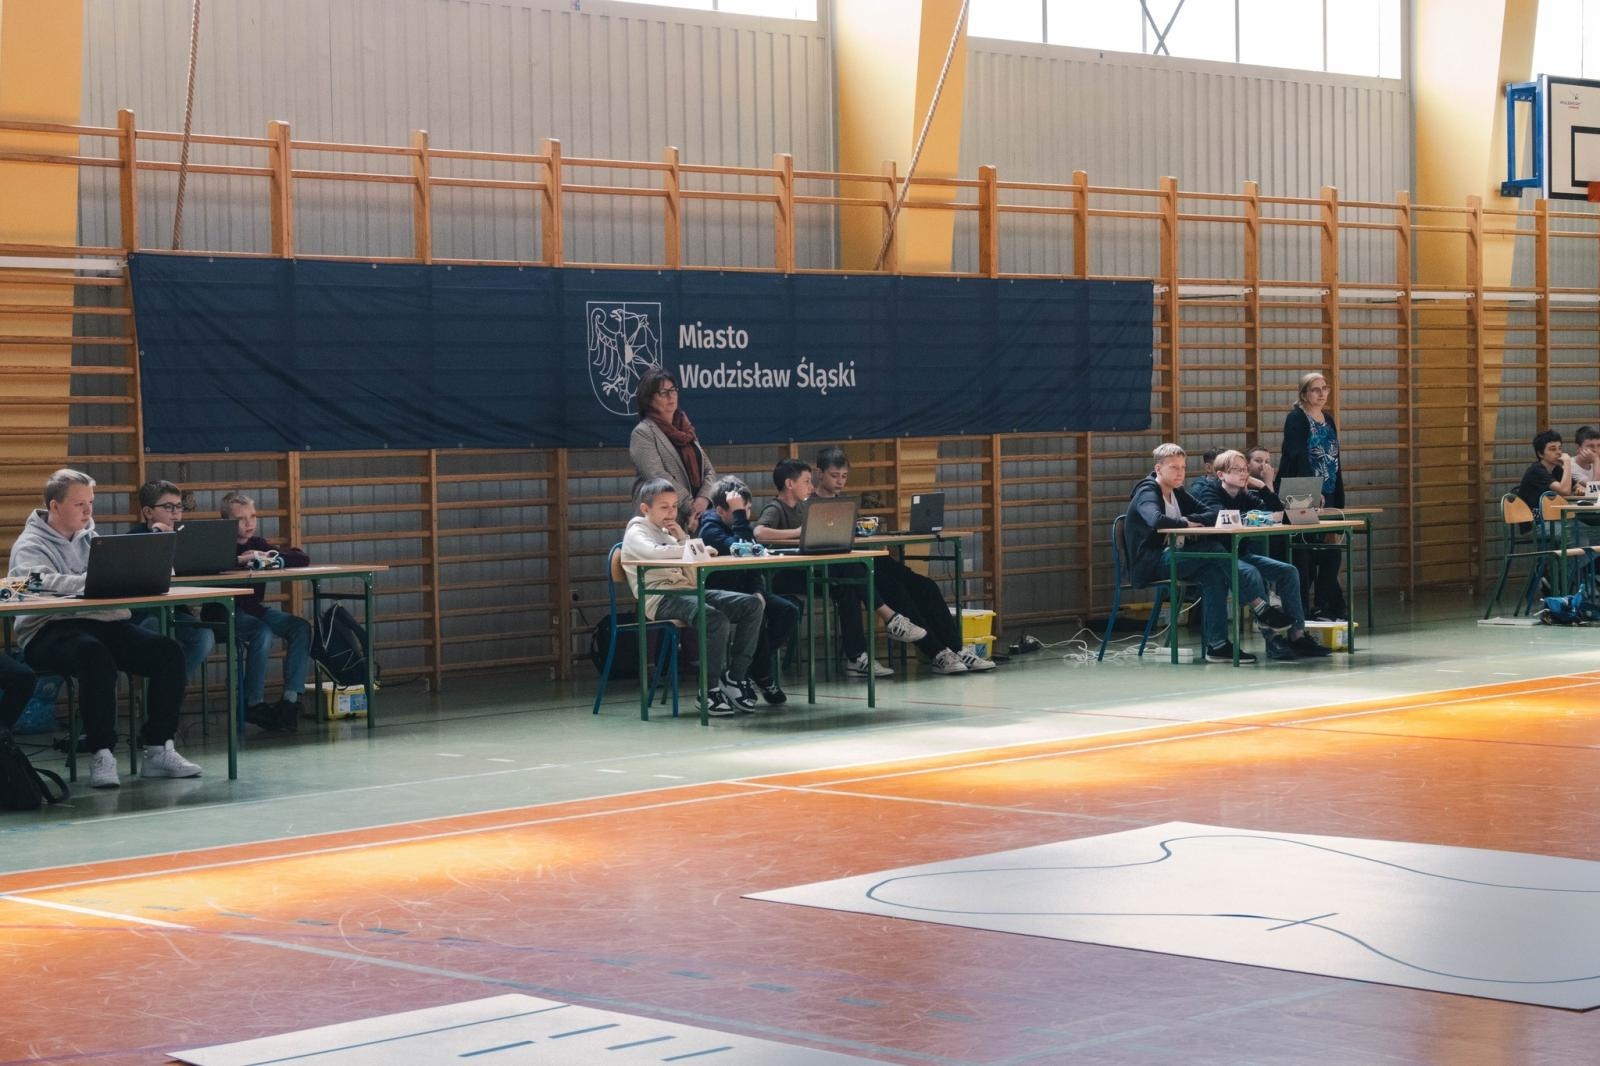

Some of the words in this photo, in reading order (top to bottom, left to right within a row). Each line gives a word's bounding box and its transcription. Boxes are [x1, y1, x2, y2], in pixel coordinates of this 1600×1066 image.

[679, 321, 749, 349] Miasto
[679, 360, 791, 389] Wodzisław
[796, 356, 856, 395] Śląski
